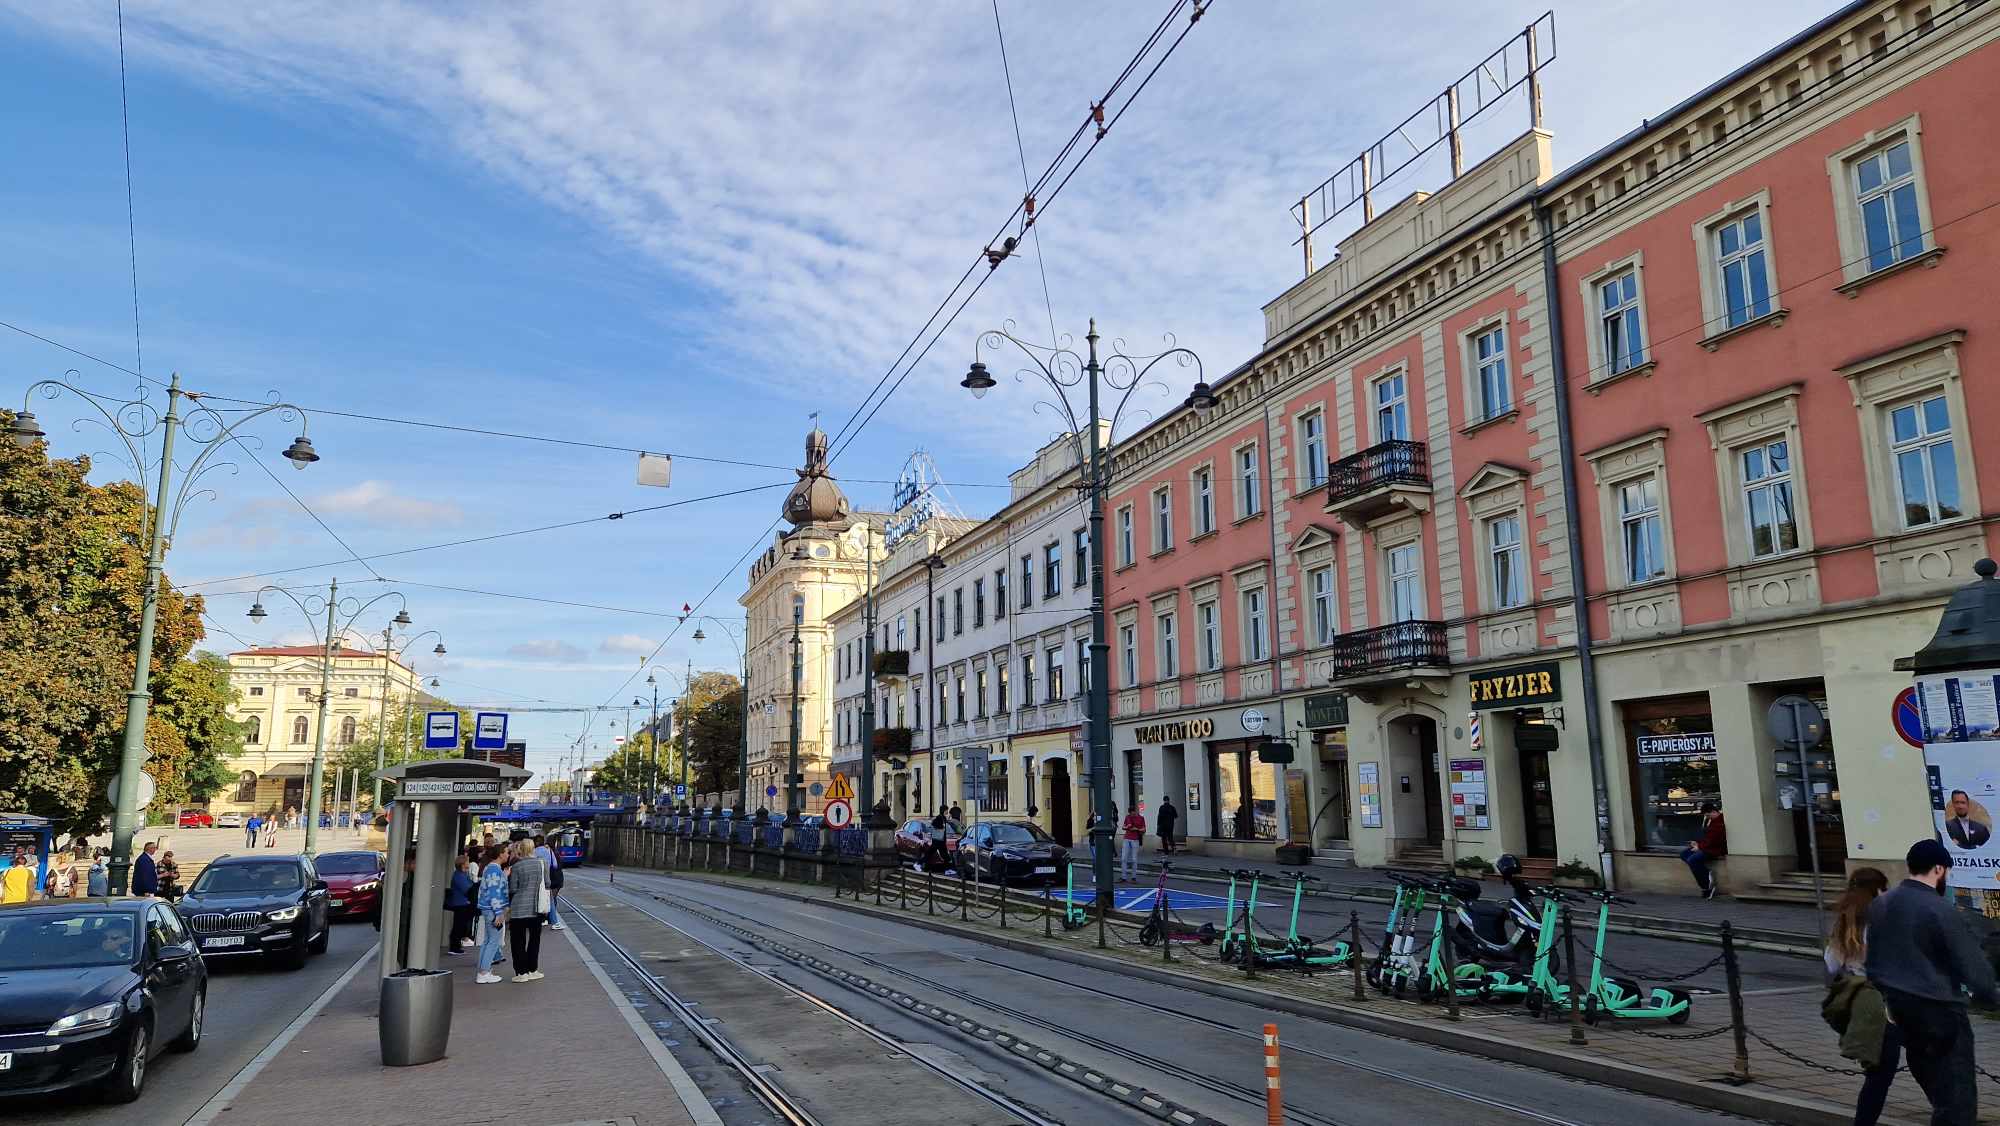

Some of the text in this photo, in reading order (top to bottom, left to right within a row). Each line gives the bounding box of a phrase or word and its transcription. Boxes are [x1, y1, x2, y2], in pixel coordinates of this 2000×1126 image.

[1470, 671, 1553, 702] FRYZJER
[1166, 718, 1214, 741] TATTOO
[1641, 736, 1717, 753] E-PAPIEROSY.PL
[677, 785, 684, 794] P
[1952, 857, 2000, 868] ISZALSK
